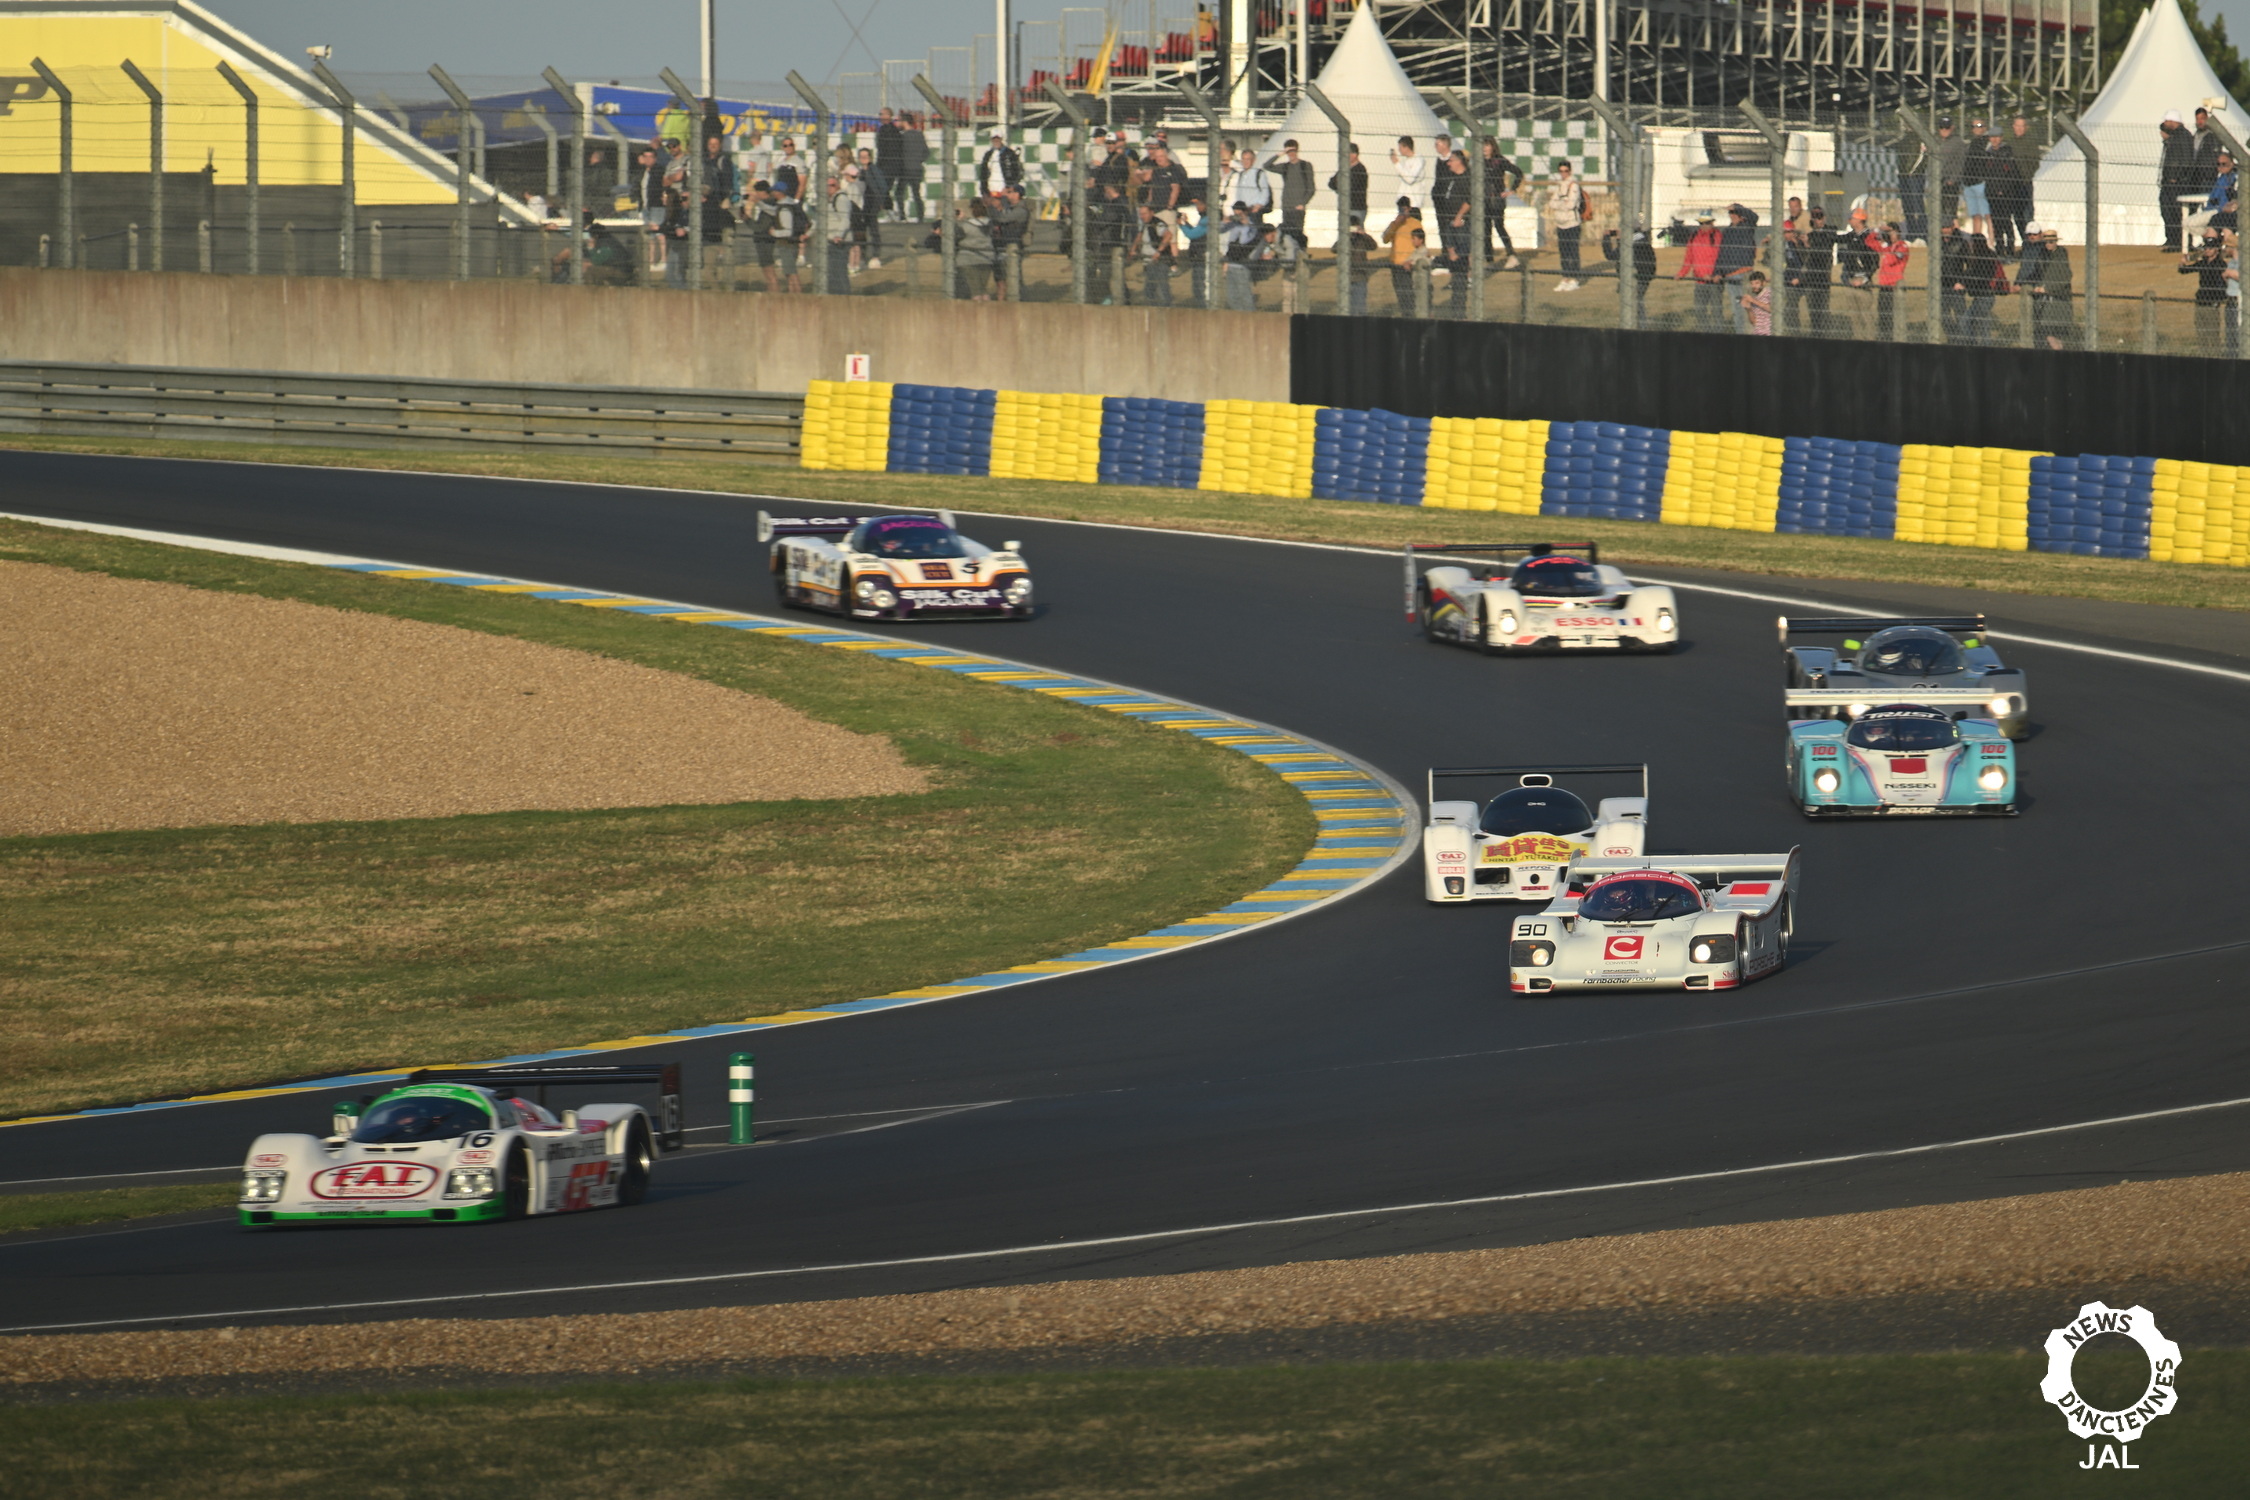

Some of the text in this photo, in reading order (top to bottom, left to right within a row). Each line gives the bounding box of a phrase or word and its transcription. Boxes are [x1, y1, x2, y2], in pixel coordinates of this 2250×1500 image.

[809, 517, 849, 525] Cut
[899, 588, 1002, 600] Silk Cut
[913, 597, 988, 609] JAGUAR
[1555, 616, 1615, 627] ESSO
[1865, 710, 1944, 719] TRUST
[1812, 746, 1838, 756] 100
[1981, 744, 2007, 754] 100
[1598, 873, 1685, 885] PORSCHE
[1517, 924, 1548, 936] 90
[1608, 937, 1639, 958] C
[458, 1131, 498, 1149] 16
